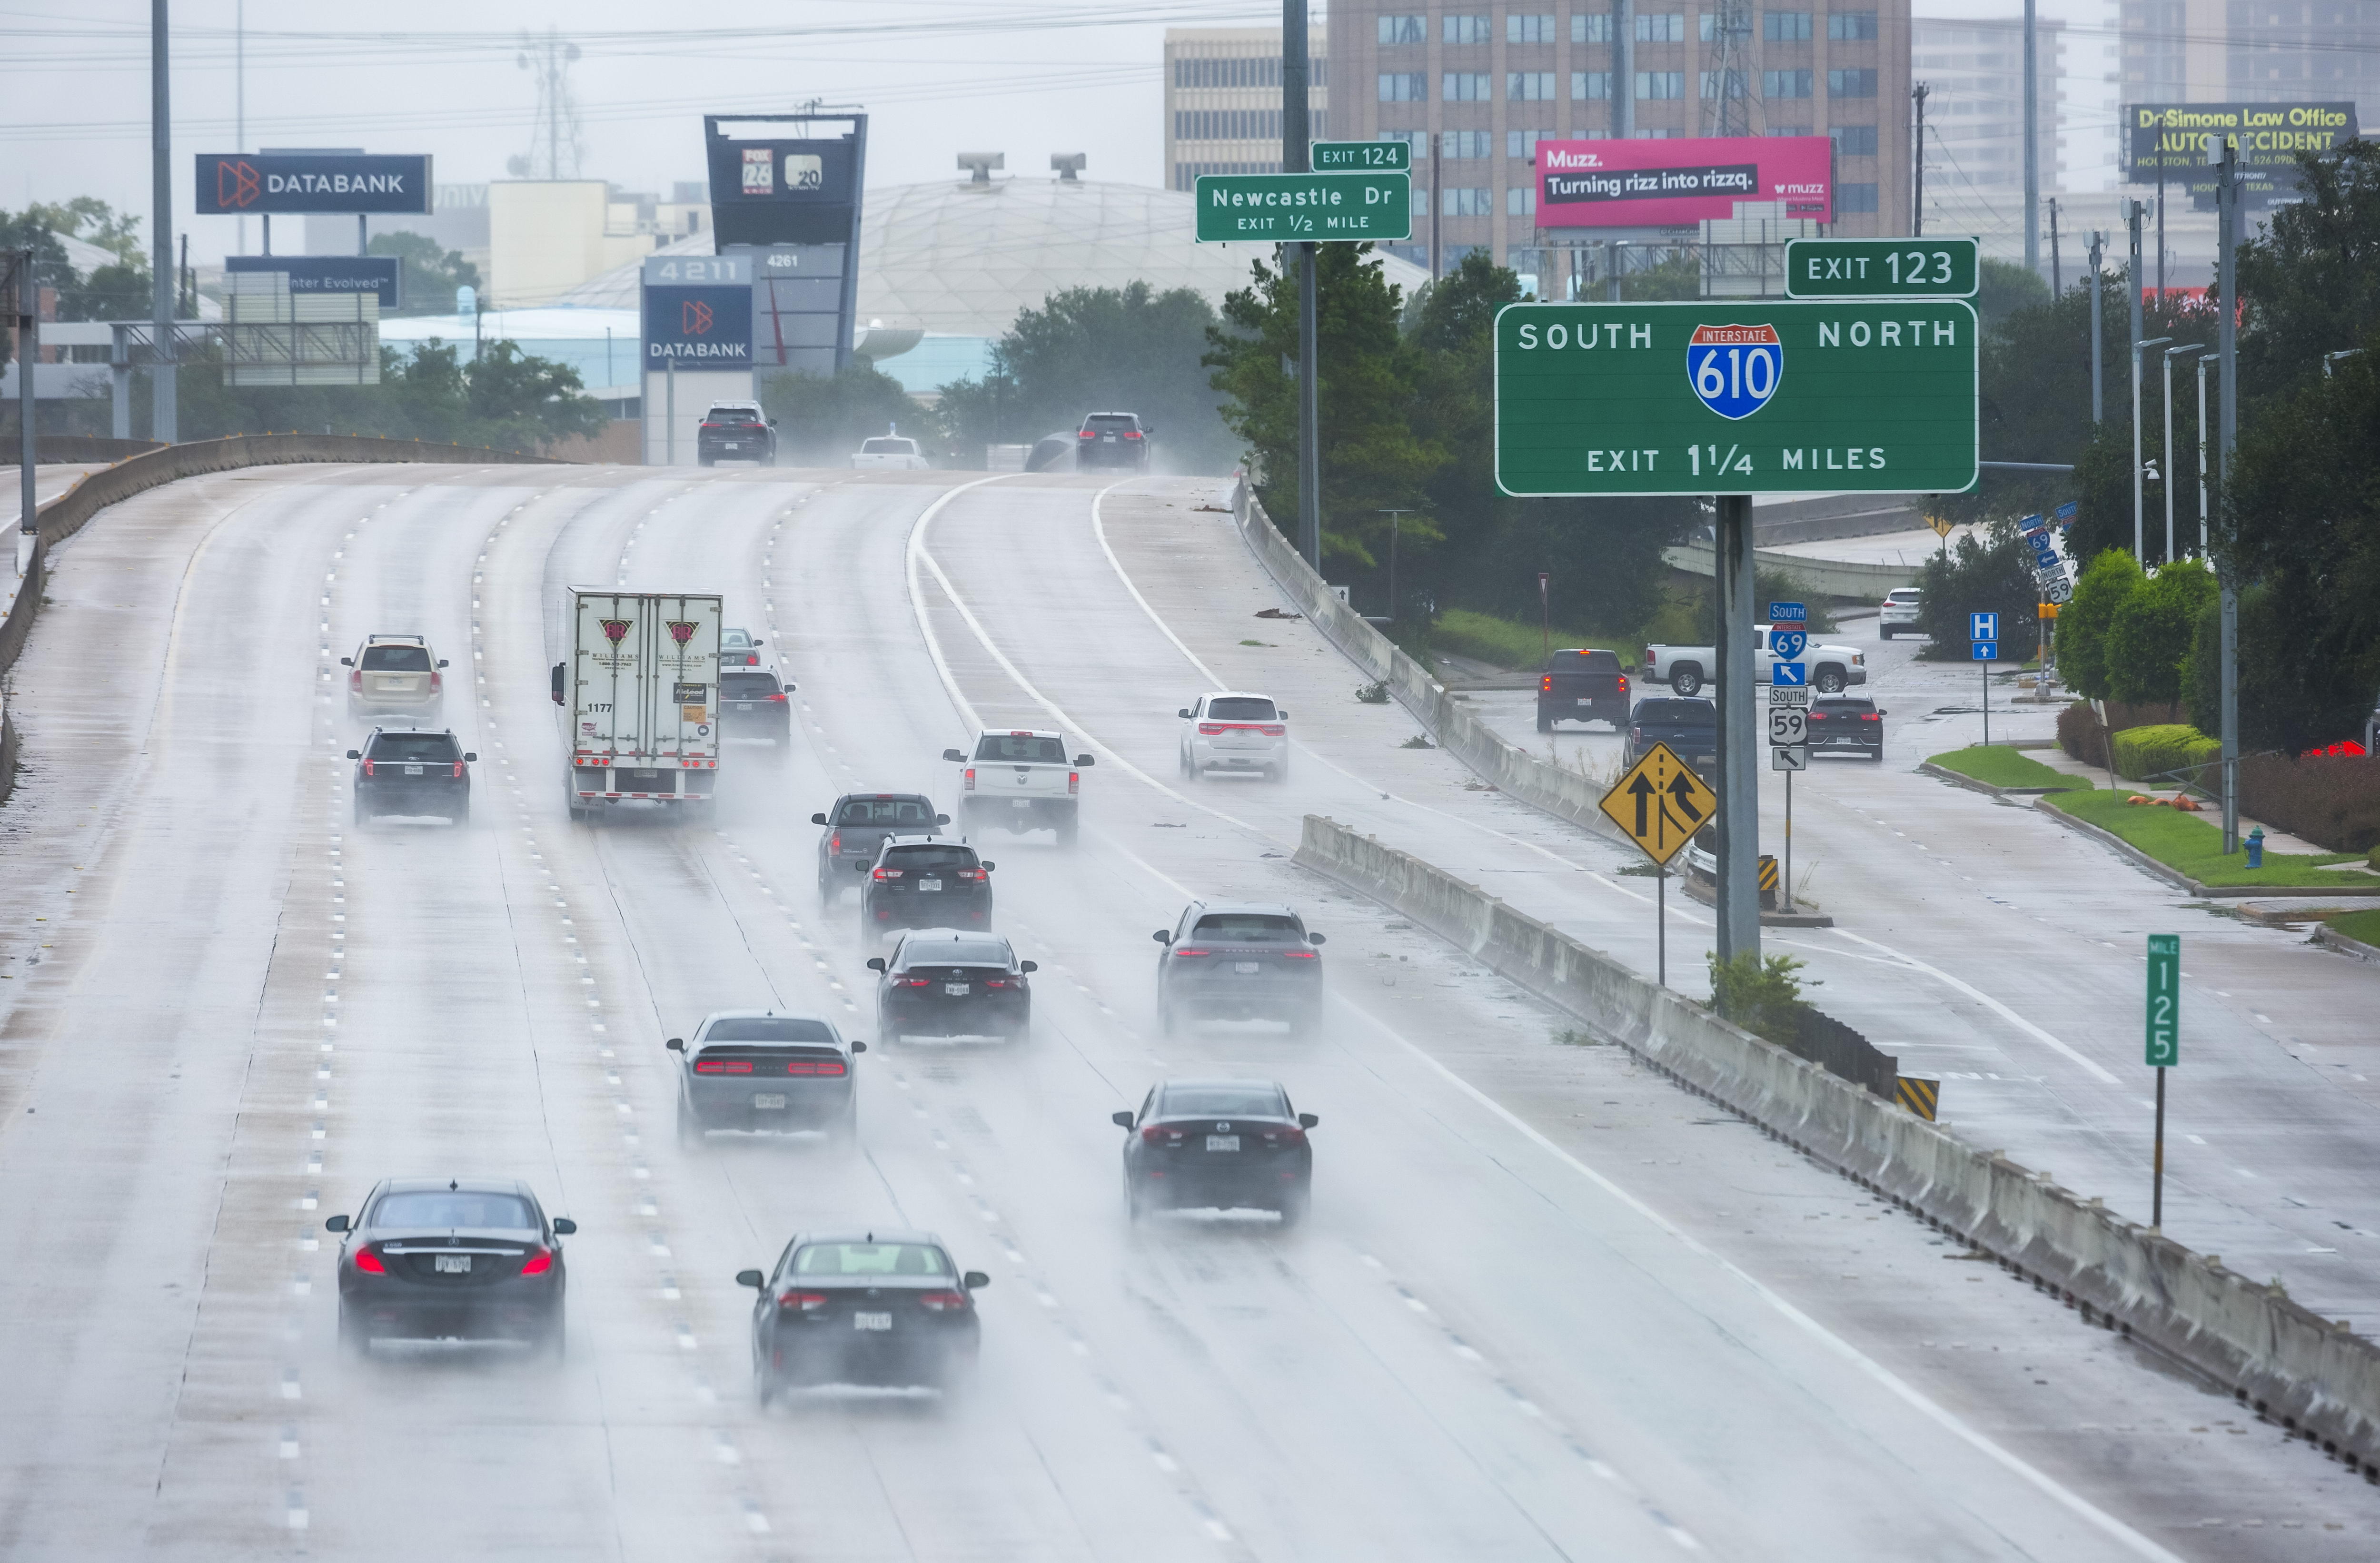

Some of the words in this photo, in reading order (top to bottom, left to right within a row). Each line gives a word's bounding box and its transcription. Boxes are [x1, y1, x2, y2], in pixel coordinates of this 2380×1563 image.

[2243, 109, 2284, 127] Law
[2289, 108, 2347, 127] Office
[746, 149, 770, 162] FOX
[1323, 151, 1354, 163] EXIT
[1362, 148, 1398, 165] 124
[1547, 150, 1603, 168] Muzz.
[2234, 154, 2297, 166] .526.0900
[744, 165, 771, 186] 26
[798, 170, 819, 186] 20
[268, 174, 404, 193] DATABANK
[1548, 175, 1621, 197] Turning
[1626, 173, 1658, 191] rizz
[1662, 171, 1698, 189] into
[1703, 170, 1753, 190] rizzq.
[1788, 184, 1824, 194] muzz
[1213, 188, 1342, 207] Newcastle
[1366, 187, 1392, 205] Dr
[1238, 218, 1275, 230] EXIT
[1327, 217, 1369, 228] MILE
[767, 254, 798, 267] 4261
[1808, 257, 1870, 279] EXIT
[1885, 252, 1952, 283] 123
[660, 262, 736, 280] 4211
[291, 277, 319, 288] nter
[1518, 324, 1651, 349] SOUTH
[1702, 330, 1767, 342] INTERSTATE
[1819, 320, 1954, 347] NORTH
[650, 343, 746, 357] DATABANK
[1697, 348, 1775, 399] 610
[1588, 450, 1659, 472] EXIT
[1783, 447, 1886, 470] MILES
[2058, 505, 2077, 518] SOUTH
[2022, 516, 2043, 531] NORTH
[2033, 534, 2048, 548] 69
[2043, 567, 2064, 578] NORTH
[2050, 584, 2069, 600] 59
[1772, 605, 1805, 618] SOUTH
[605, 624, 626, 638] BR
[671, 626, 693, 640] BR
[1974, 614, 1994, 638] H
[1776, 634, 1803, 653] 69
[1772, 690, 1805, 702] SOUTH
[588, 703, 612, 712] 1177
[1774, 715, 1802, 736] 59
[2150, 940, 2178, 955] MILE
